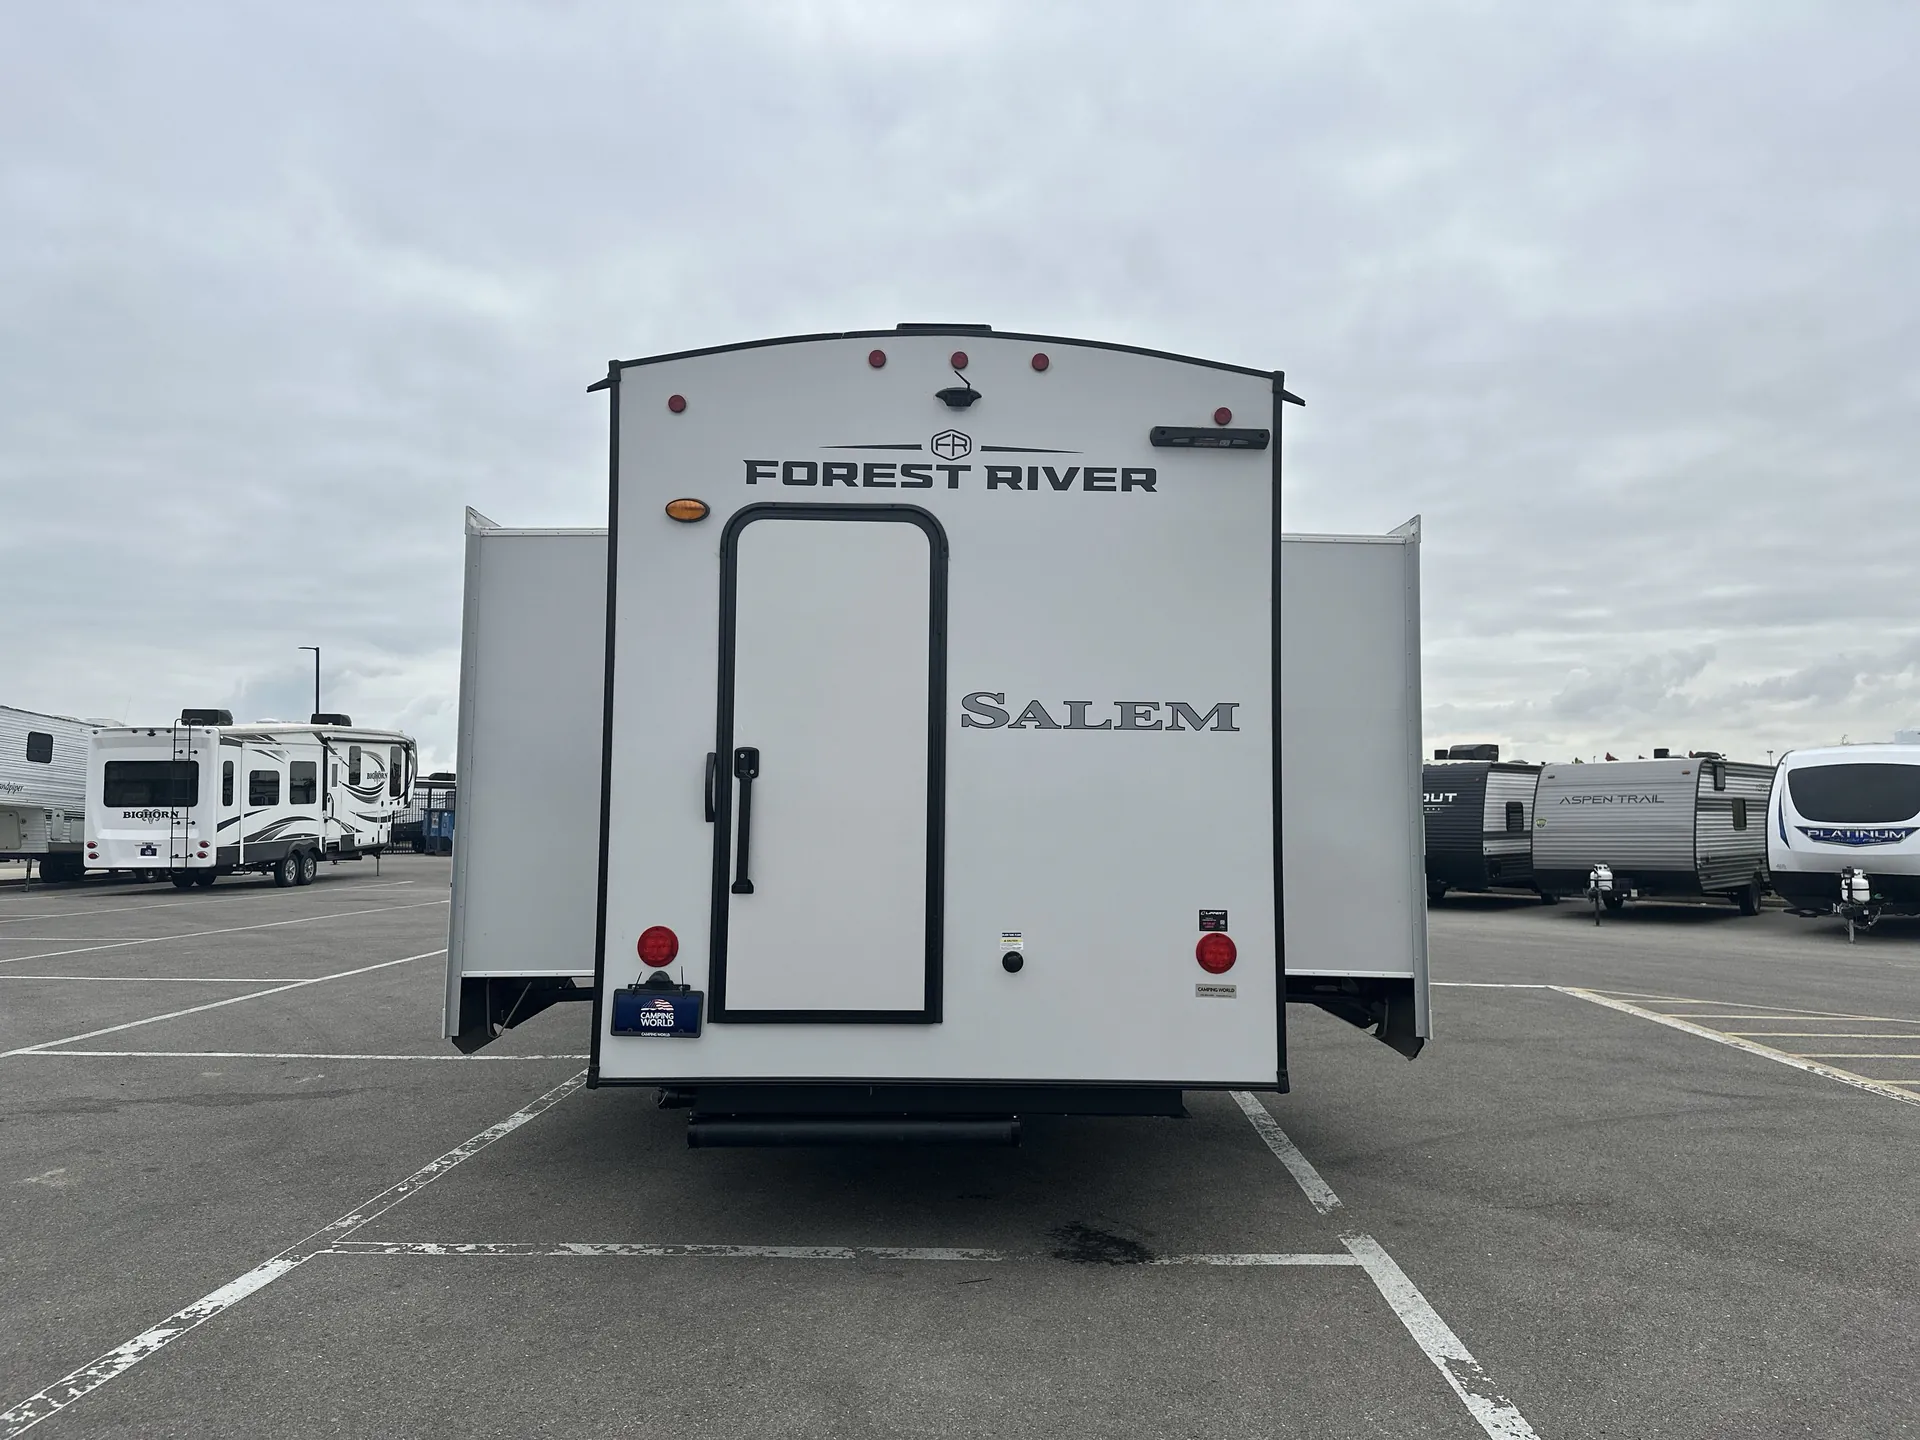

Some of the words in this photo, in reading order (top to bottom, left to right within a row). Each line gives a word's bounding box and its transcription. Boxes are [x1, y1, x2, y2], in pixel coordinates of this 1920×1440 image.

[743, 460, 971, 489] FOREST
[984, 465, 1158, 492] RIVER
[961, 691, 1240, 732] SALEM
[1559, 795, 1613, 805] ASPEN
[1617, 794, 1665, 804] TRAIL
[122, 811, 179, 819] BIGHORN
[1807, 829, 1906, 839] PLATINUM
[640, 1011, 674, 1020] CAMPING
[640, 1018, 674, 1027] WORLD
